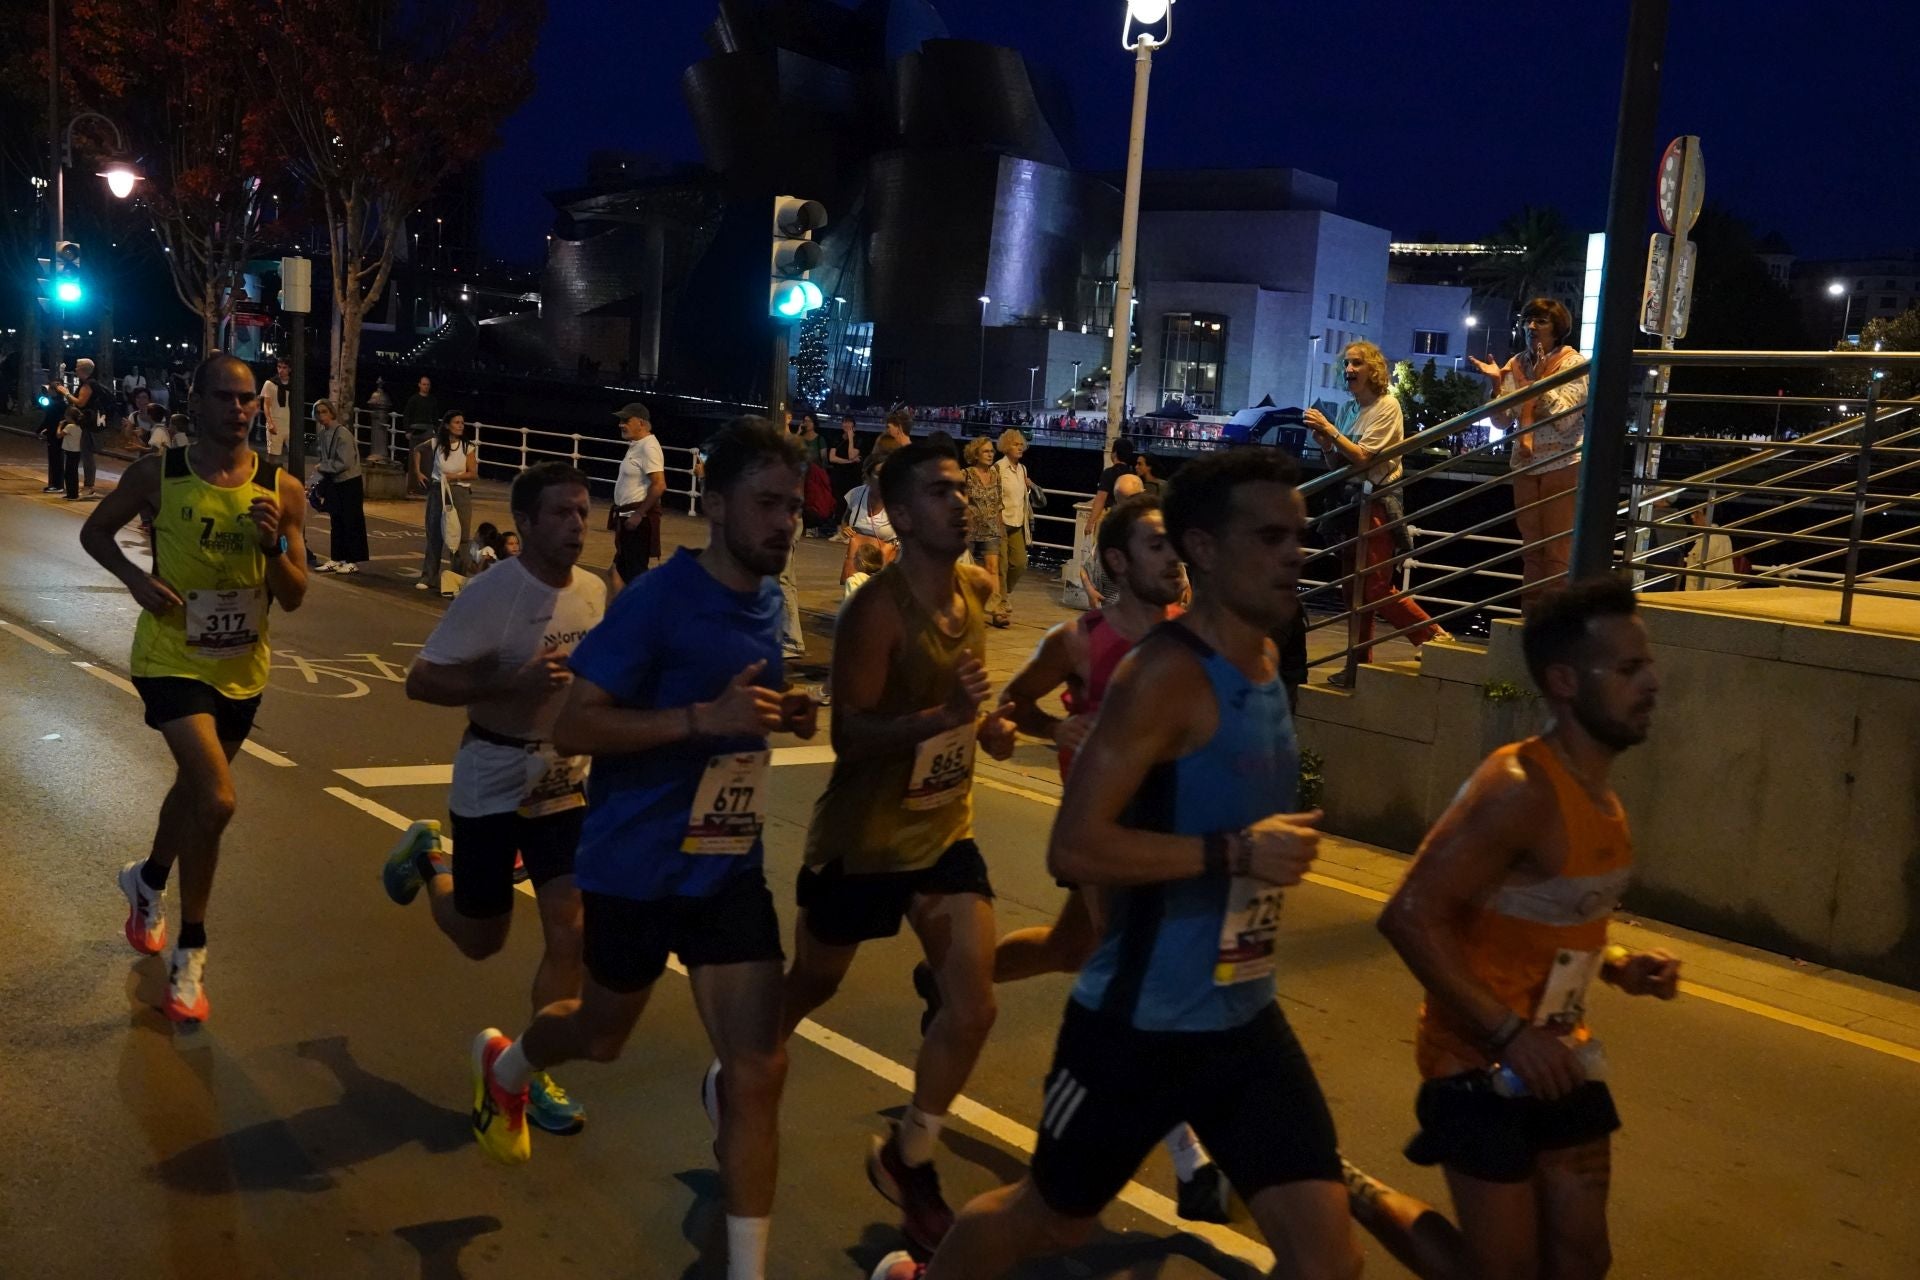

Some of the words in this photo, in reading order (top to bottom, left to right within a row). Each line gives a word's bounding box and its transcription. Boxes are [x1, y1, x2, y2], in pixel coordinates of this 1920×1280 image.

[201, 517, 215, 540] 7
[206, 613, 246, 631] 317
[713, 786, 754, 812] 677
